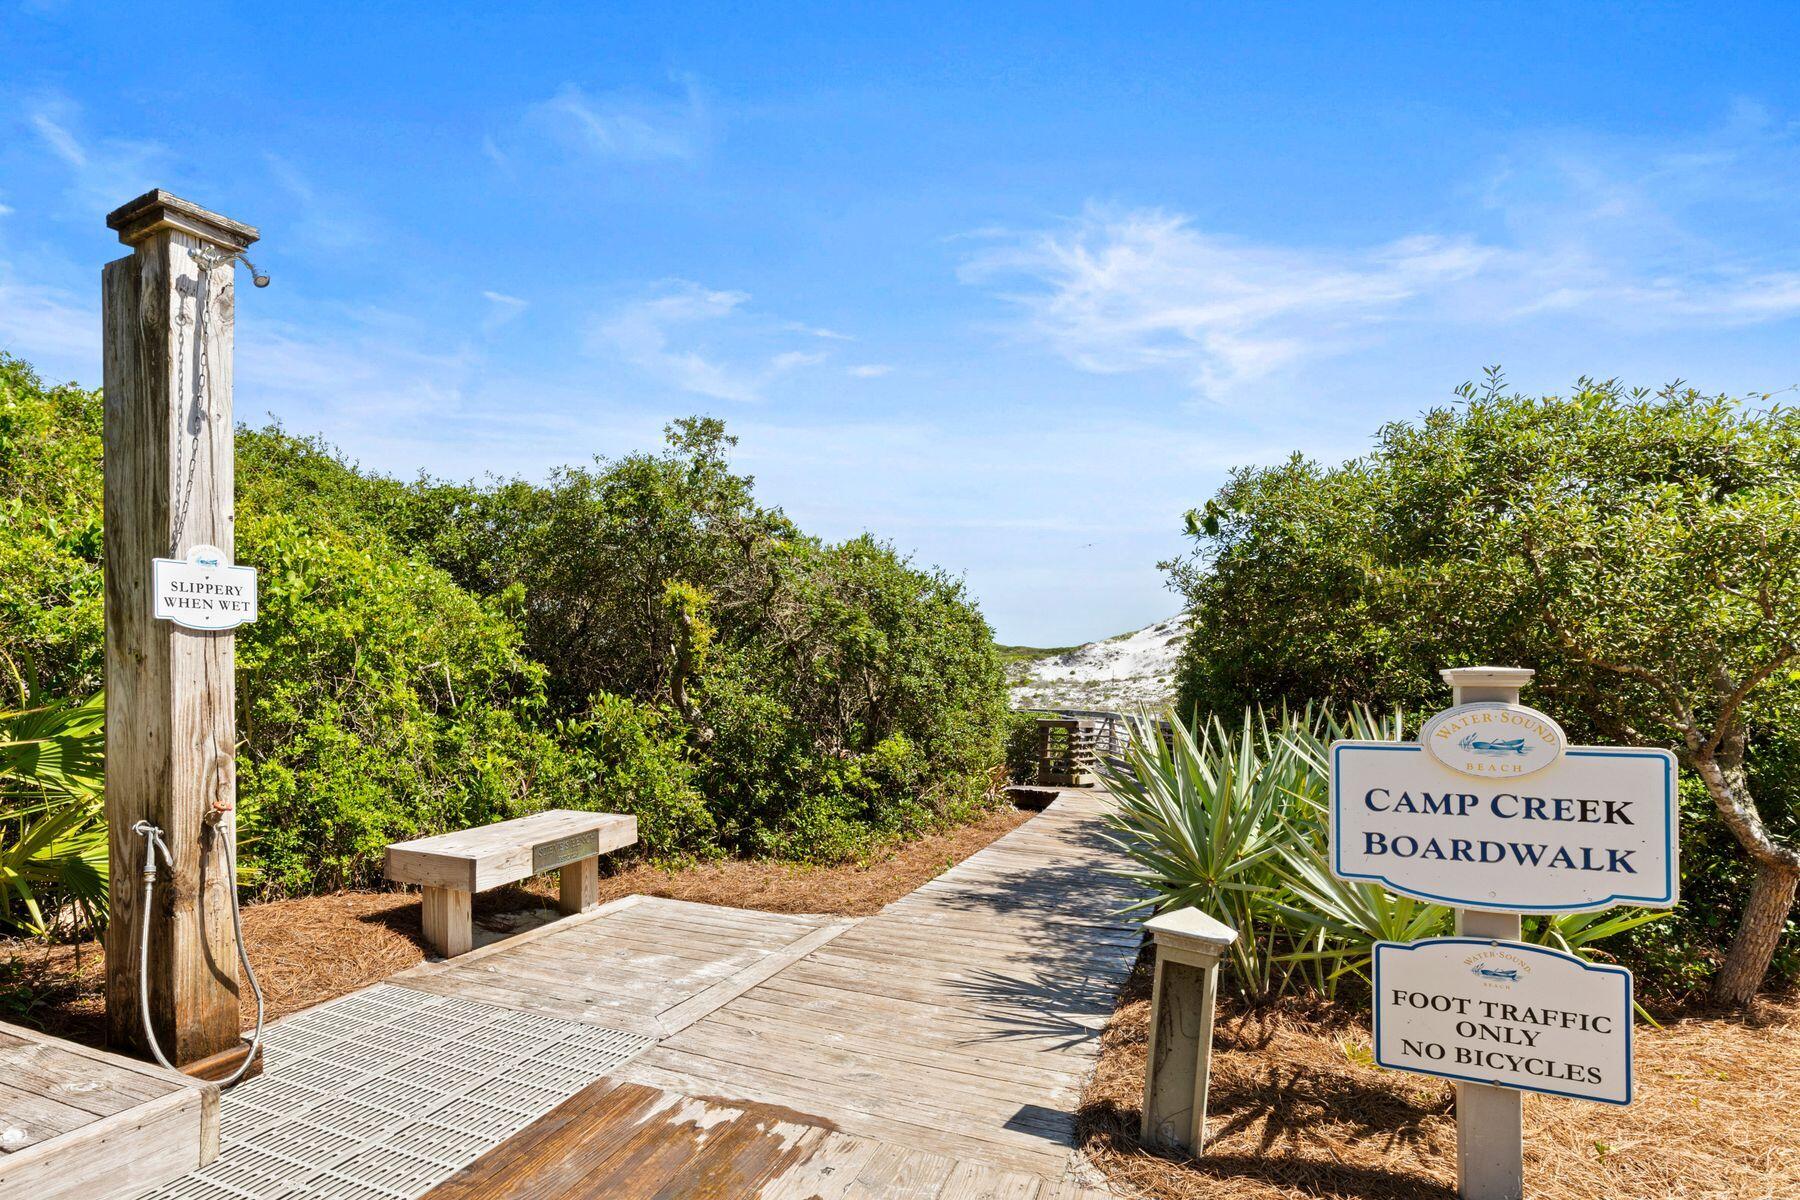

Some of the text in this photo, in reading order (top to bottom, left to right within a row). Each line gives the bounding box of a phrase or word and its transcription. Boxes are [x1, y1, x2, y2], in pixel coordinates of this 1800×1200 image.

[164, 596, 250, 611] WHEN WET
[170, 581, 243, 596] SLIPPERY
[1466, 762, 1521, 772] BEACH
[1364, 788, 1635, 825] CAMP CREEK
[1362, 831, 1638, 874] BOARDWALK
[1391, 989, 1612, 1034] FOOT TRAFFIC
[1456, 1021, 1541, 1048] ONLY
[1401, 1038, 1602, 1085] NO BICYCLES
